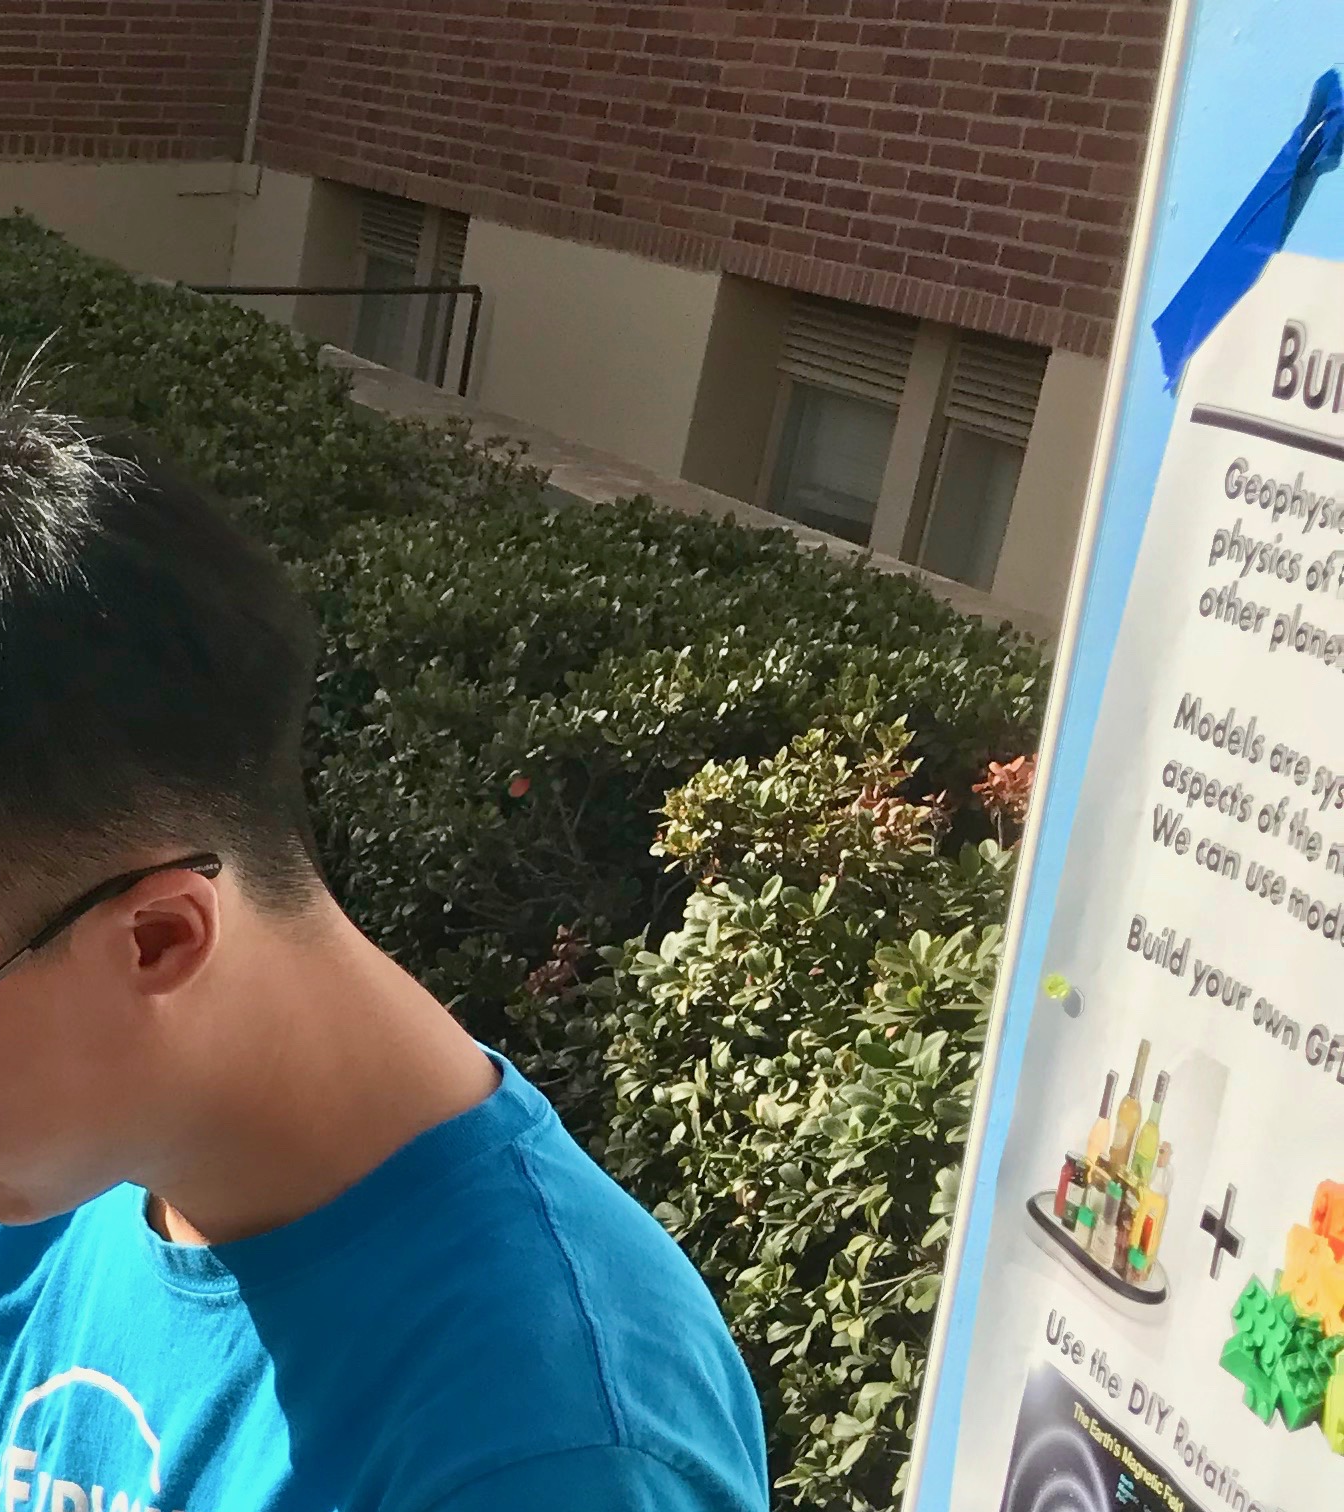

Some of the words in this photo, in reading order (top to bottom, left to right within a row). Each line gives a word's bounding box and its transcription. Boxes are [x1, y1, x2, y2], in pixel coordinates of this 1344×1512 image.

[1208, 518, 1303, 583] physics
[1305, 550, 1337, 593] of
[1199, 580, 1271, 633] other
[1173, 692, 1266, 764] Models
[1269, 742, 1311, 786] are
[1152, 803, 1191, 855] We
[1195, 838, 1241, 880] can
[1245, 861, 1287, 905] use
[1162, 759, 1254, 823] aspects
[1257, 796, 1290, 837] of
[1288, 808, 1323, 862] the
[1126, 913, 1192, 977] Build
[1188, 958, 1253, 1011] your
[1252, 997, 1300, 1051] own
[1046, 1309, 1085, 1365] Use
[1088, 1348, 1123, 1399] the
[1127, 1378, 1174, 1435] DIY
[1073, 1401, 1091, 1429] The
[1089, 1417, 1122, 1458] Earth's
[1120, 1446, 1163, 1495] Magnetic
